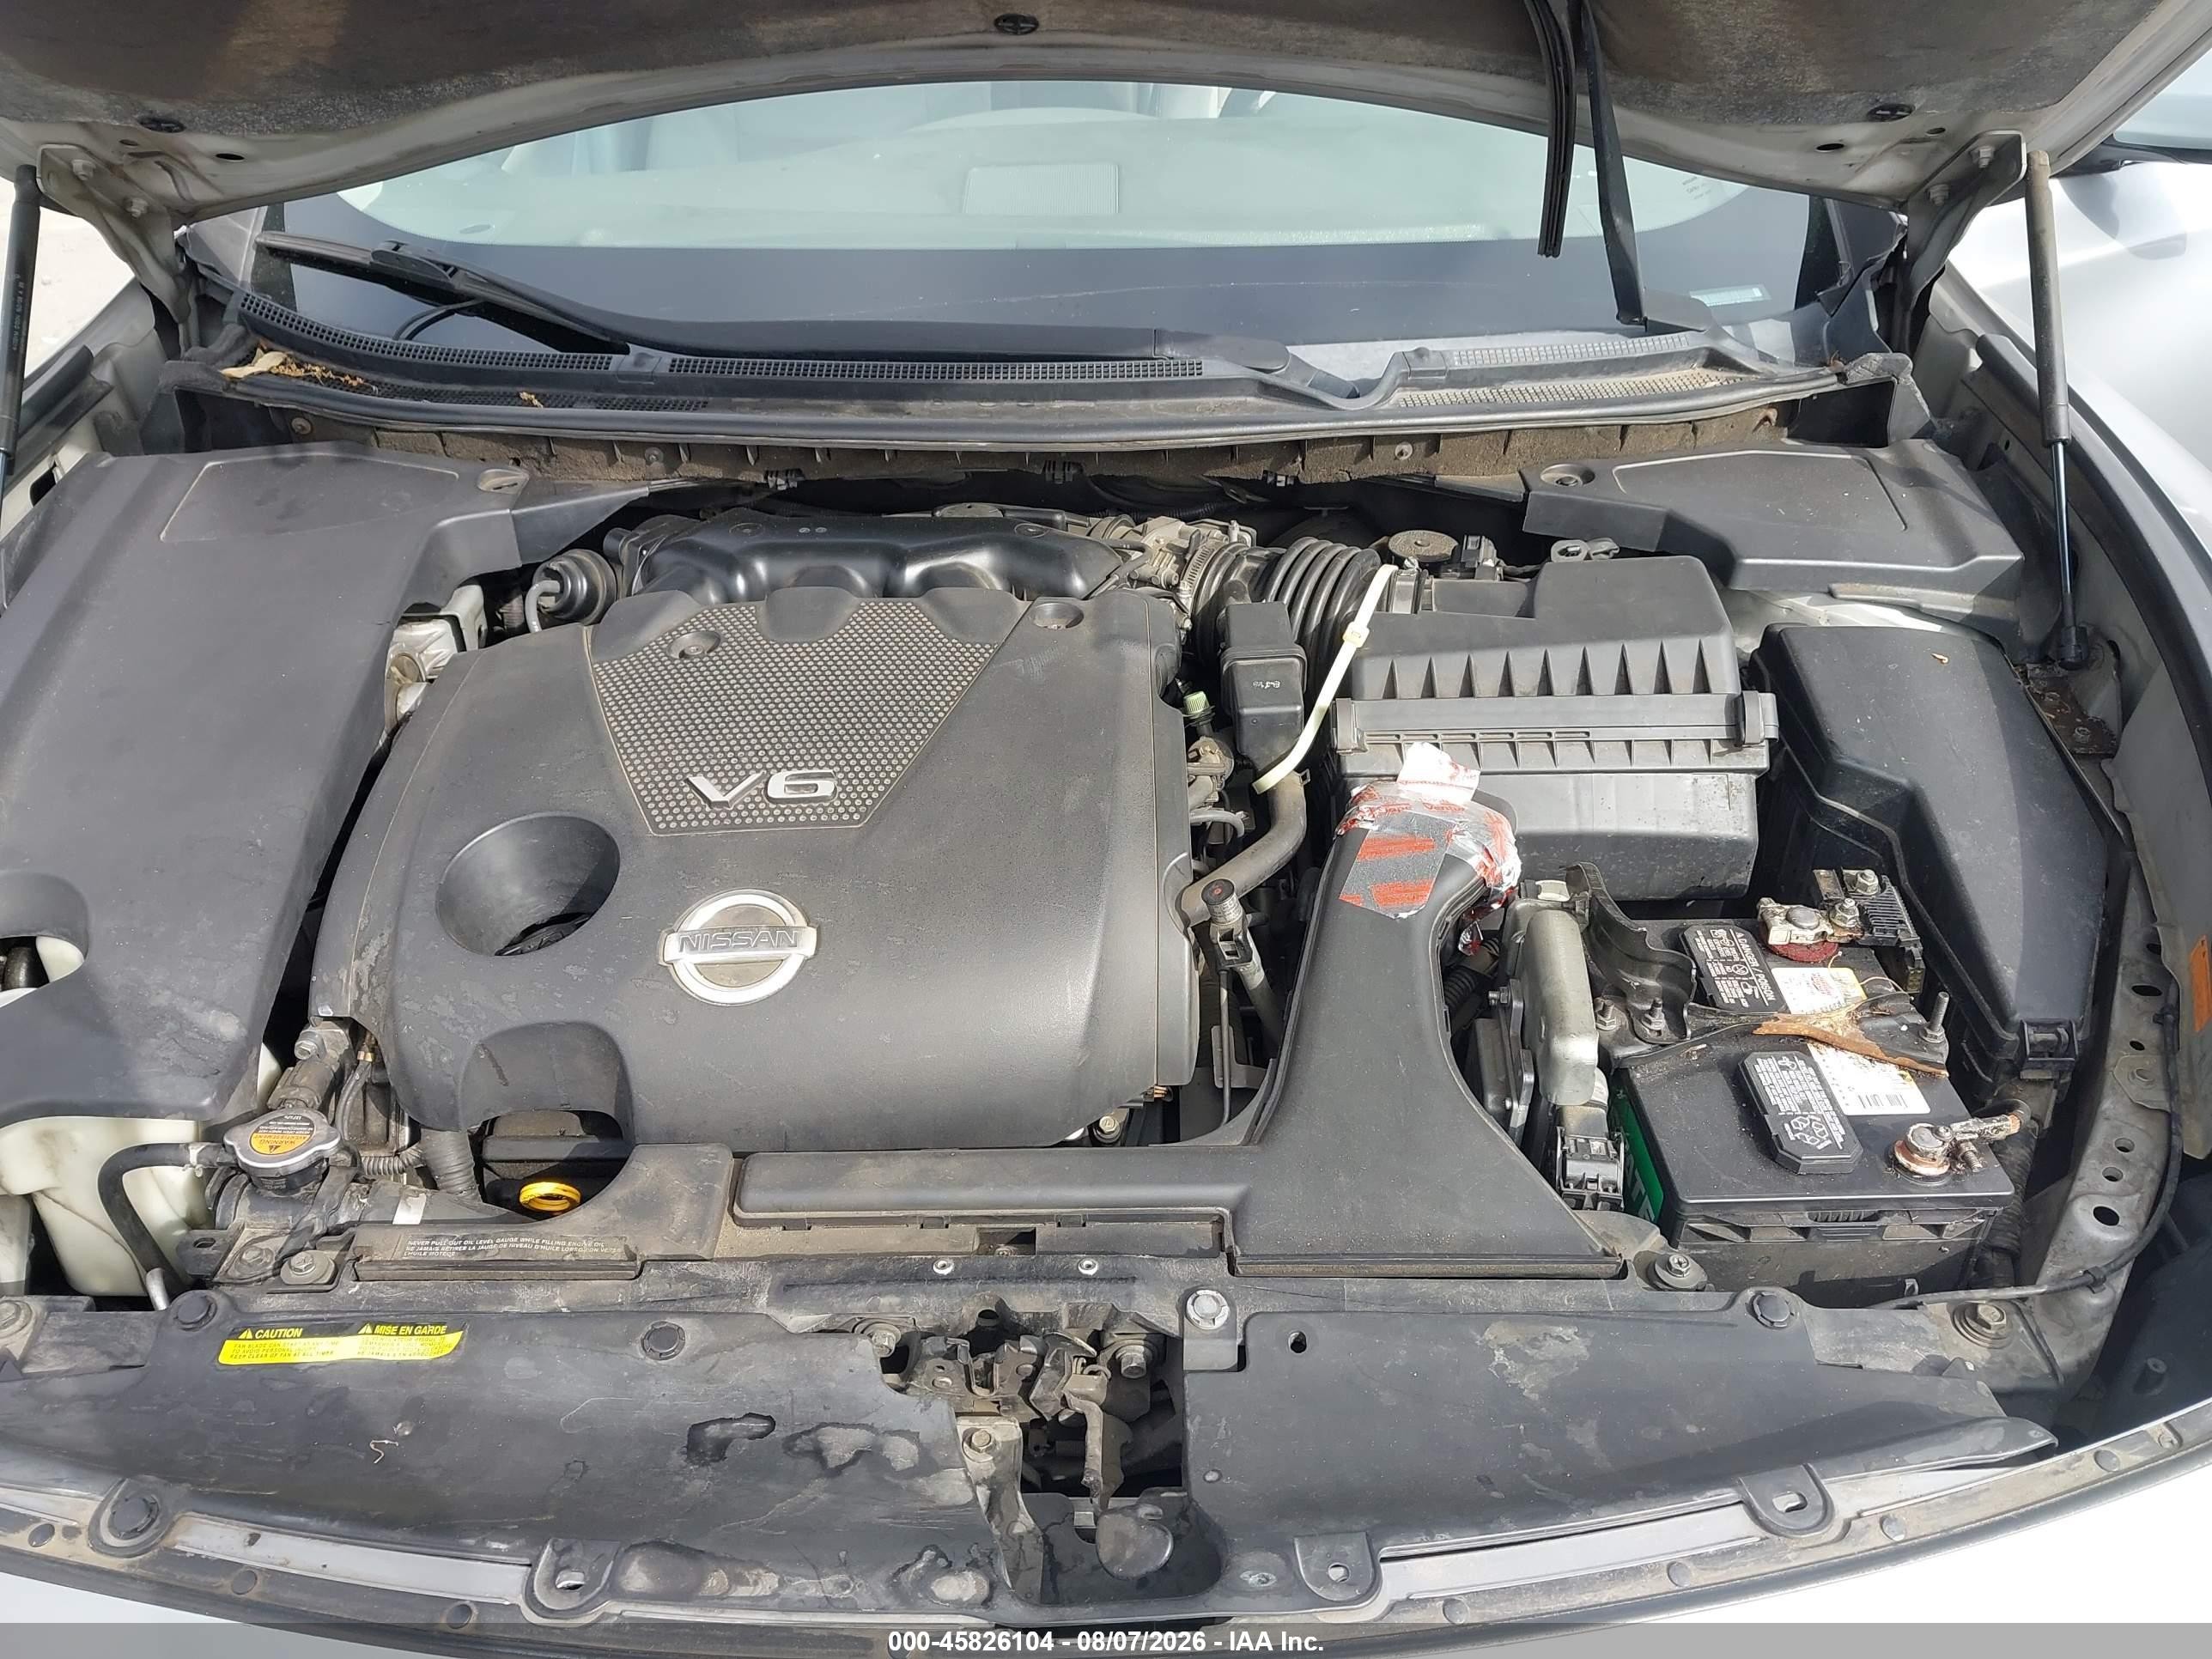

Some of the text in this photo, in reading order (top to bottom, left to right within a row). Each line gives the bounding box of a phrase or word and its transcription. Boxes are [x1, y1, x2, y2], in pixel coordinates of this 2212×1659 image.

[684, 769, 838, 810] V6
[678, 930, 798, 952] NISSAN
[1737, 938, 1759, 970] DANGER
[1757, 972, 1777, 1001] POISON
[255, 1328, 303, 1340] CAUTION
[374, 1325, 447, 1335] MISE EN GARDE
